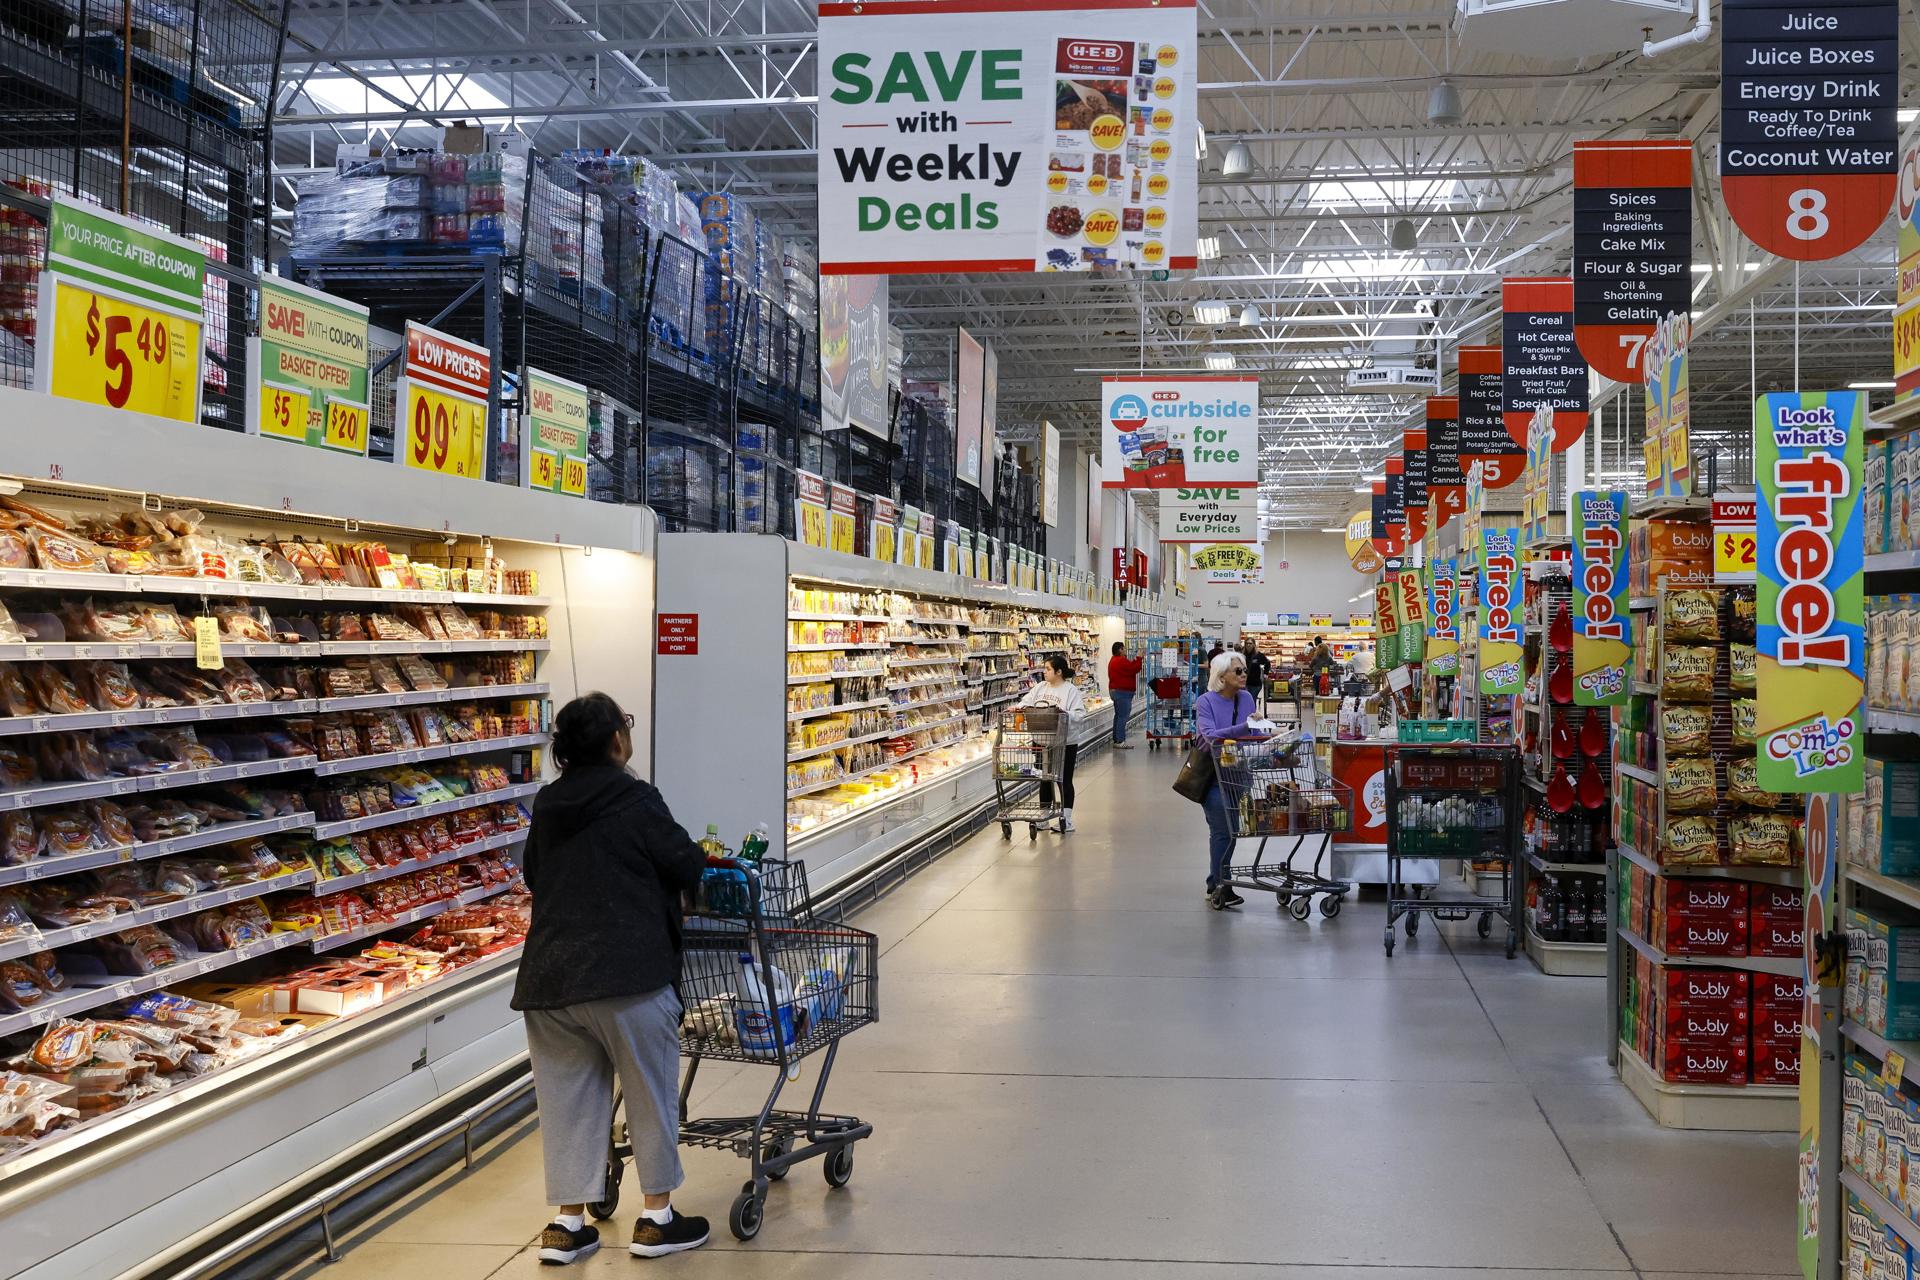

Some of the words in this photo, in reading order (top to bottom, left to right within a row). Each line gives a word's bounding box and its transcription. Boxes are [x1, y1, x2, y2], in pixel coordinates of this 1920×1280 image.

[1781, 14, 1839, 31] Juice
[1746, 48, 1804, 66] Juice
[1809, 47, 1875, 65] Boxes
[830, 49, 1023, 104] SAVE
[1740, 81, 1815, 102] Energy
[1823, 80, 1880, 98] Drink
[896, 111, 958, 133] with
[1748, 110, 1798, 126] Ready
[1804, 110, 1823, 122] To
[1827, 109, 1872, 122] Drink
[1092, 124, 1125, 137] SAVE!
[1764, 124, 1855, 139] Coffee/Tea
[833, 143, 1022, 187] Weekly
[1728, 150, 1819, 167] Coconut
[1826, 149, 1893, 166] Water
[1609, 193, 1656, 207] Spices
[858, 193, 999, 231] Deals
[1614, 212, 1652, 224] Baking
[1786, 188, 1829, 241] 8
[1085, 220, 1119, 233] SAVE!
[1602, 221, 1664, 233] Ingredients
[62, 221, 92, 251] YOUR
[93, 230, 123, 257] PRICE
[124, 243, 156, 271] AFTER
[157, 255, 197, 281] COUPON
[1600, 238, 1637, 251] Cake
[1641, 238, 1666, 251] Mix
[1584, 261, 1622, 275] Flour
[1626, 262, 1637, 275] &
[1640, 262, 1682, 277] Sugar
[1620, 281, 1637, 291] Oil
[1638, 281, 1647, 290] &
[1603, 290, 1663, 301] Shortening
[1529, 316, 1563, 325] Cereal
[1607, 307, 1659, 321] Gelatin
[267, 302, 305, 338] SAVE!
[305, 319, 328, 343] WITH
[329, 326, 364, 351] COUPON
[1517, 333, 1538, 342] Hot
[1540, 333, 1574, 342] Cereal
[1522, 346, 1554, 354] Pancake
[1556, 346, 1571, 354] Mix
[1538, 354, 1562, 362] Syrup
[1619, 335, 1648, 369] 7
[418, 338, 444, 366] LOW
[446, 350, 481, 381] PRICES
[280, 353, 317, 378] BASKET
[318, 362, 349, 387] OFFER!
[1508, 366, 1559, 375] Breakfast
[1561, 366, 1584, 375] Bars
[1470, 390, 1486, 398] Hot
[1547, 387, 1567, 396] Cups
[273, 390, 291, 428] $5
[533, 389, 553, 414] SAVE!
[553, 398, 566, 412] WITH
[566, 401, 586, 419] COUPON
[1151, 399, 1251, 418] curbside
[1485, 403, 1501, 411] Tea
[1512, 399, 1550, 411] Special
[1553, 399, 1581, 408] Diets
[1466, 417, 1485, 425] Rice
[1781, 408, 1833, 425] Look
[540, 424, 559, 442] BASKET
[1193, 426, 1228, 443] for
[1462, 430, 1490, 438] Boxed
[1775, 428, 1845, 445] what's
[1193, 446, 1240, 463] free
[1483, 460, 1501, 481] 5
[1177, 488, 1240, 500] SAVE
[1445, 490, 1460, 508] 4
[1585, 500, 1613, 510] Look
[1720, 505, 1750, 516] LOW
[1179, 513, 1237, 524] Everyday
[1583, 512, 1620, 521] what's
[1176, 524, 1200, 533] Low
[1204, 524, 1240, 533] Prices
[1386, 541, 1394, 553] 1
[1488, 535, 1510, 543] Look
[1673, 532, 1712, 547] bubly
[1217, 550, 1235, 559] FREE
[1486, 544, 1515, 552] what's
[1779, 456, 1845, 662] free!
[1586, 526, 1621, 638] free!
[1670, 569, 1711, 584] bubly
[1400, 573, 1423, 621] SAVE!
[1487, 555, 1516, 642] free!
[1377, 586, 1397, 634] SAVE!
[1485, 664, 1519, 681] Combo
[1581, 666, 1624, 689] Combo
[1495, 675, 1518, 688] Loco
[1593, 681, 1622, 700] Loco
[1769, 719, 1852, 759] Combo
[1793, 747, 1850, 776] Loco
[1689, 891, 1730, 908] bubly
[1688, 928, 1729, 945] bubly
[1867, 941, 1888, 965] Welch's
[1689, 982, 1730, 999] bubly
[1688, 1019, 1729, 1036] bubly
[1687, 1055, 1728, 1073] bubly
[1844, 1078, 1864, 1102] Welch's
[1865, 1092, 1884, 1117] Welch's
[1884, 1108, 1906, 1133] Welch's
[1849, 1216, 1870, 1241] Welch's
[1884, 1252, 1906, 1279] Welch's
